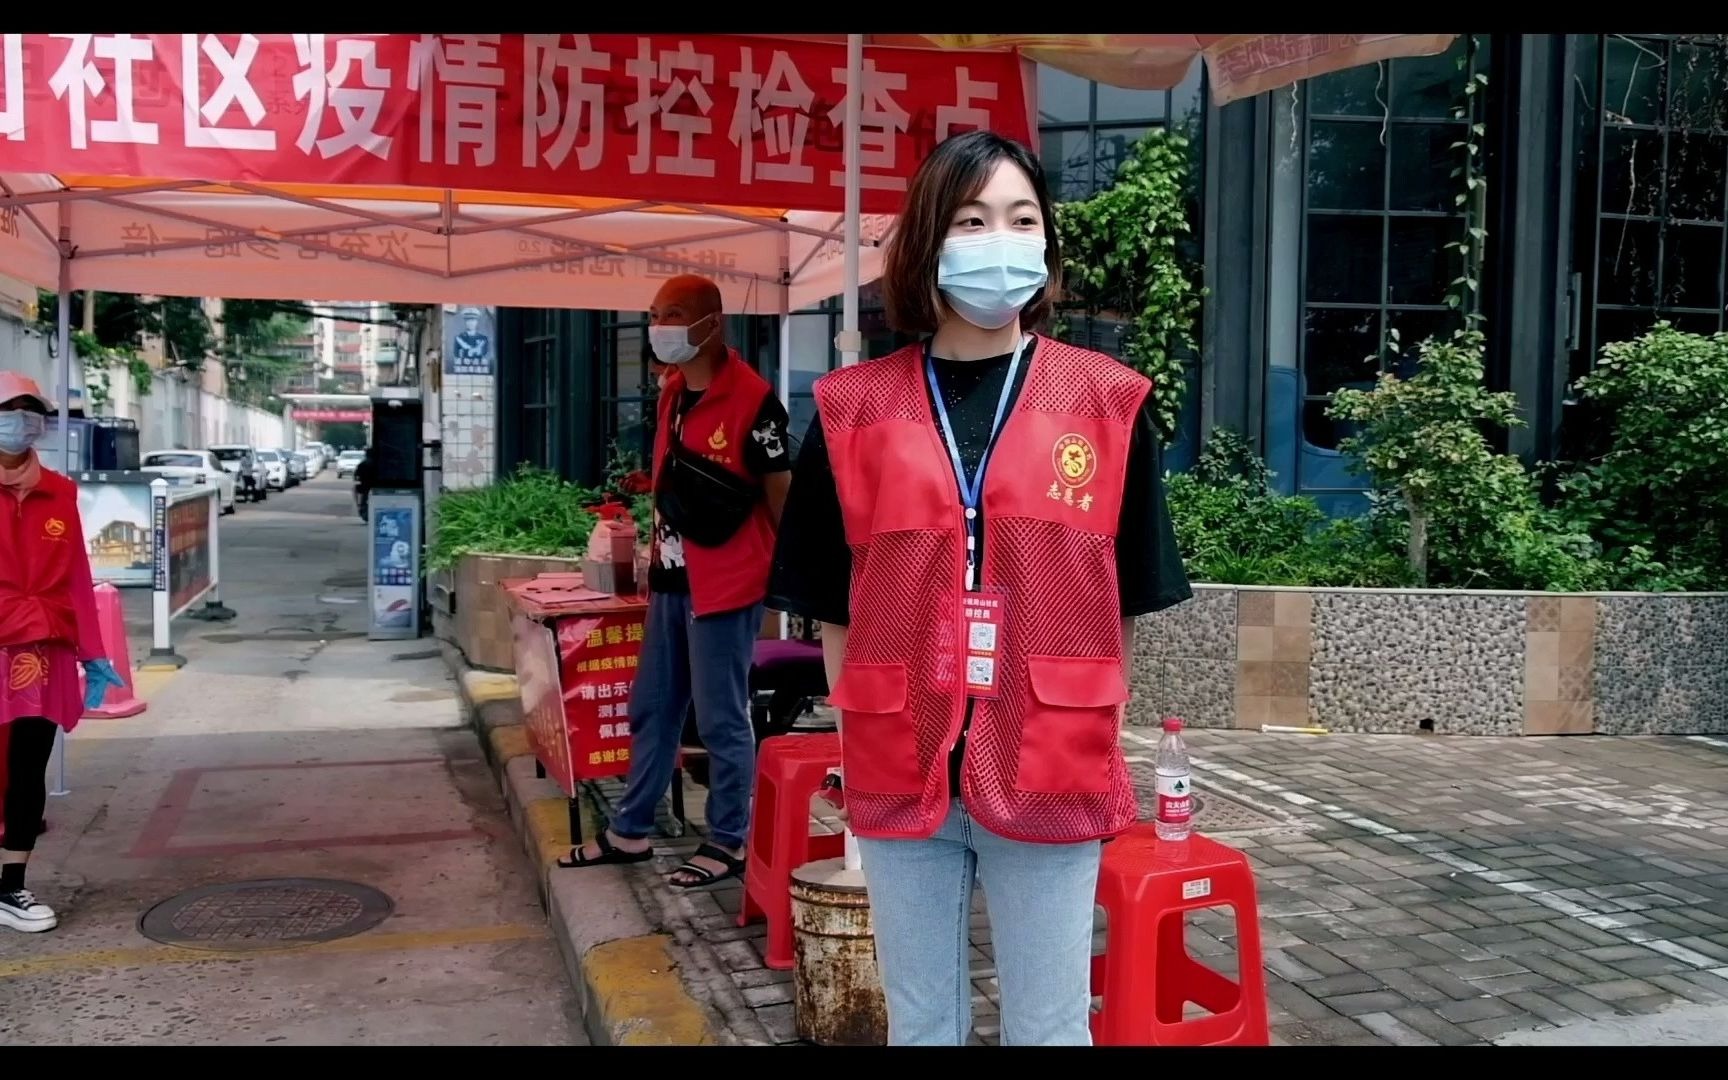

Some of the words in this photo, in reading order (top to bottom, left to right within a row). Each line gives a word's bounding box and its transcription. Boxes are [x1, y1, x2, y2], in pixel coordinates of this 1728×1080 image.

[1046, 480, 1094, 512] 志愿者
[586, 624, 645, 647] 温馨提
[582, 682, 633, 700] 请出示
[599, 703, 629, 718] 测量
[600, 723, 631, 739] 佩戴
[589, 749, 630, 764] 感谢您
